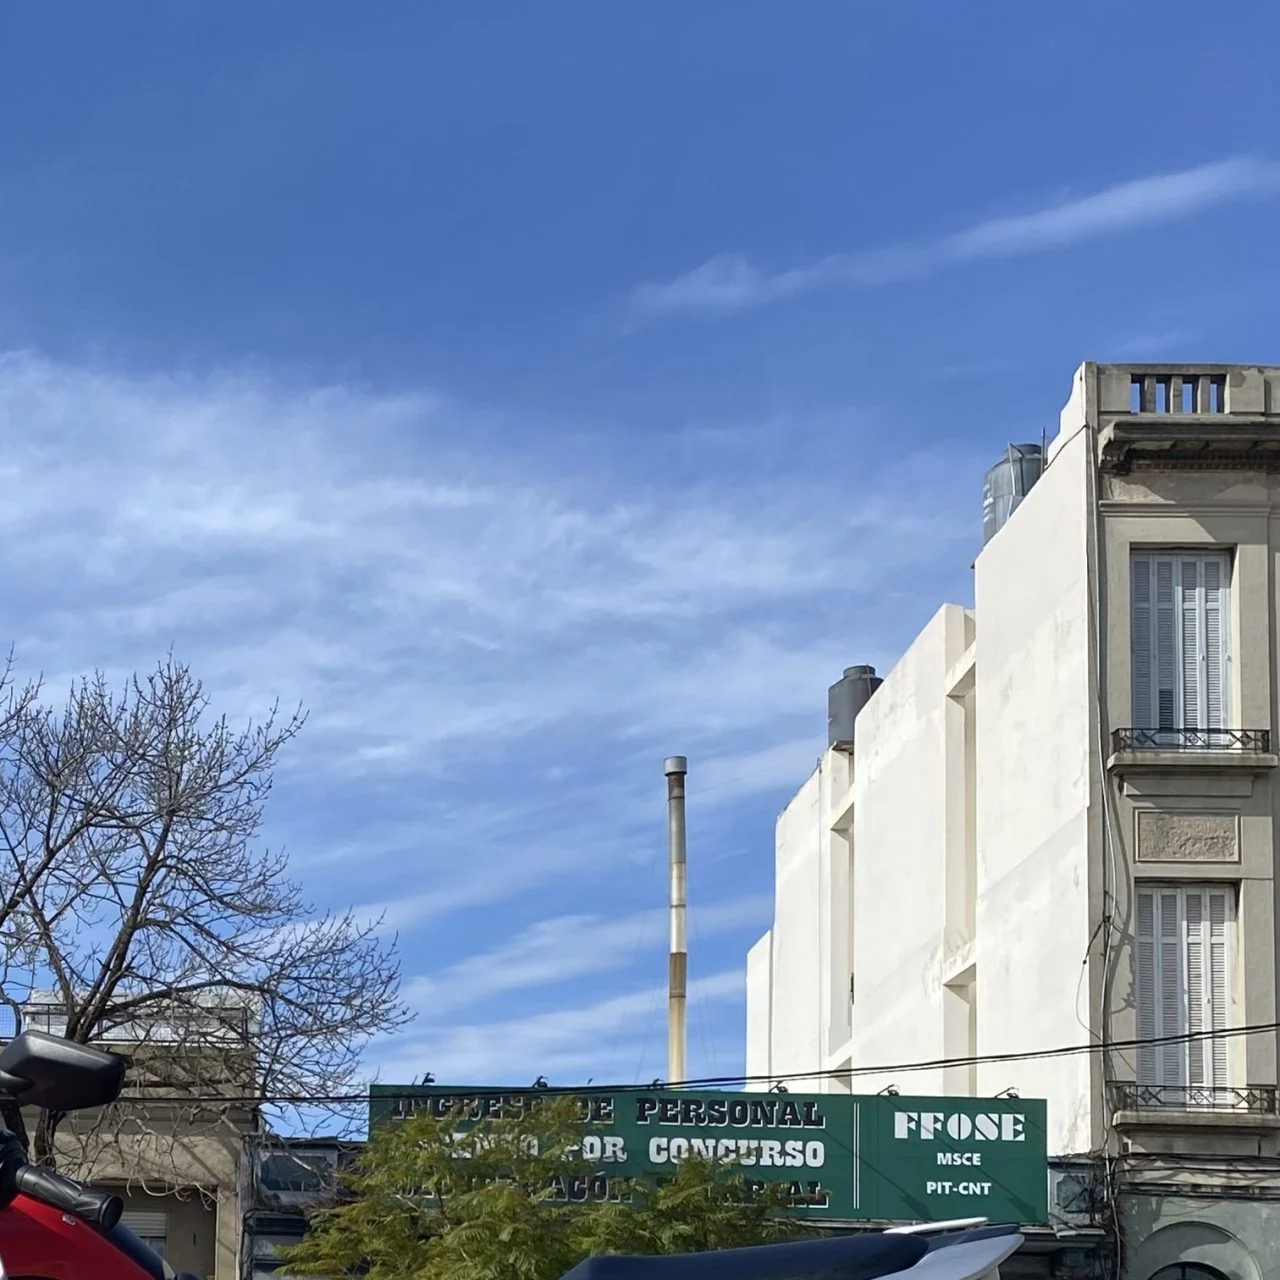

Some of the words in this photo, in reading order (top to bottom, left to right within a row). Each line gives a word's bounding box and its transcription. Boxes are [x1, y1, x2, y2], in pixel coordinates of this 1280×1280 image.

[635, 1097, 826, 1129] PERSONAL
[894, 1111, 1025, 1142] FFOSE
[648, 1136, 825, 1167] CONCURSO
[936, 1152, 981, 1166] MSCE
[926, 1181, 992, 1195] PIT-CNT
